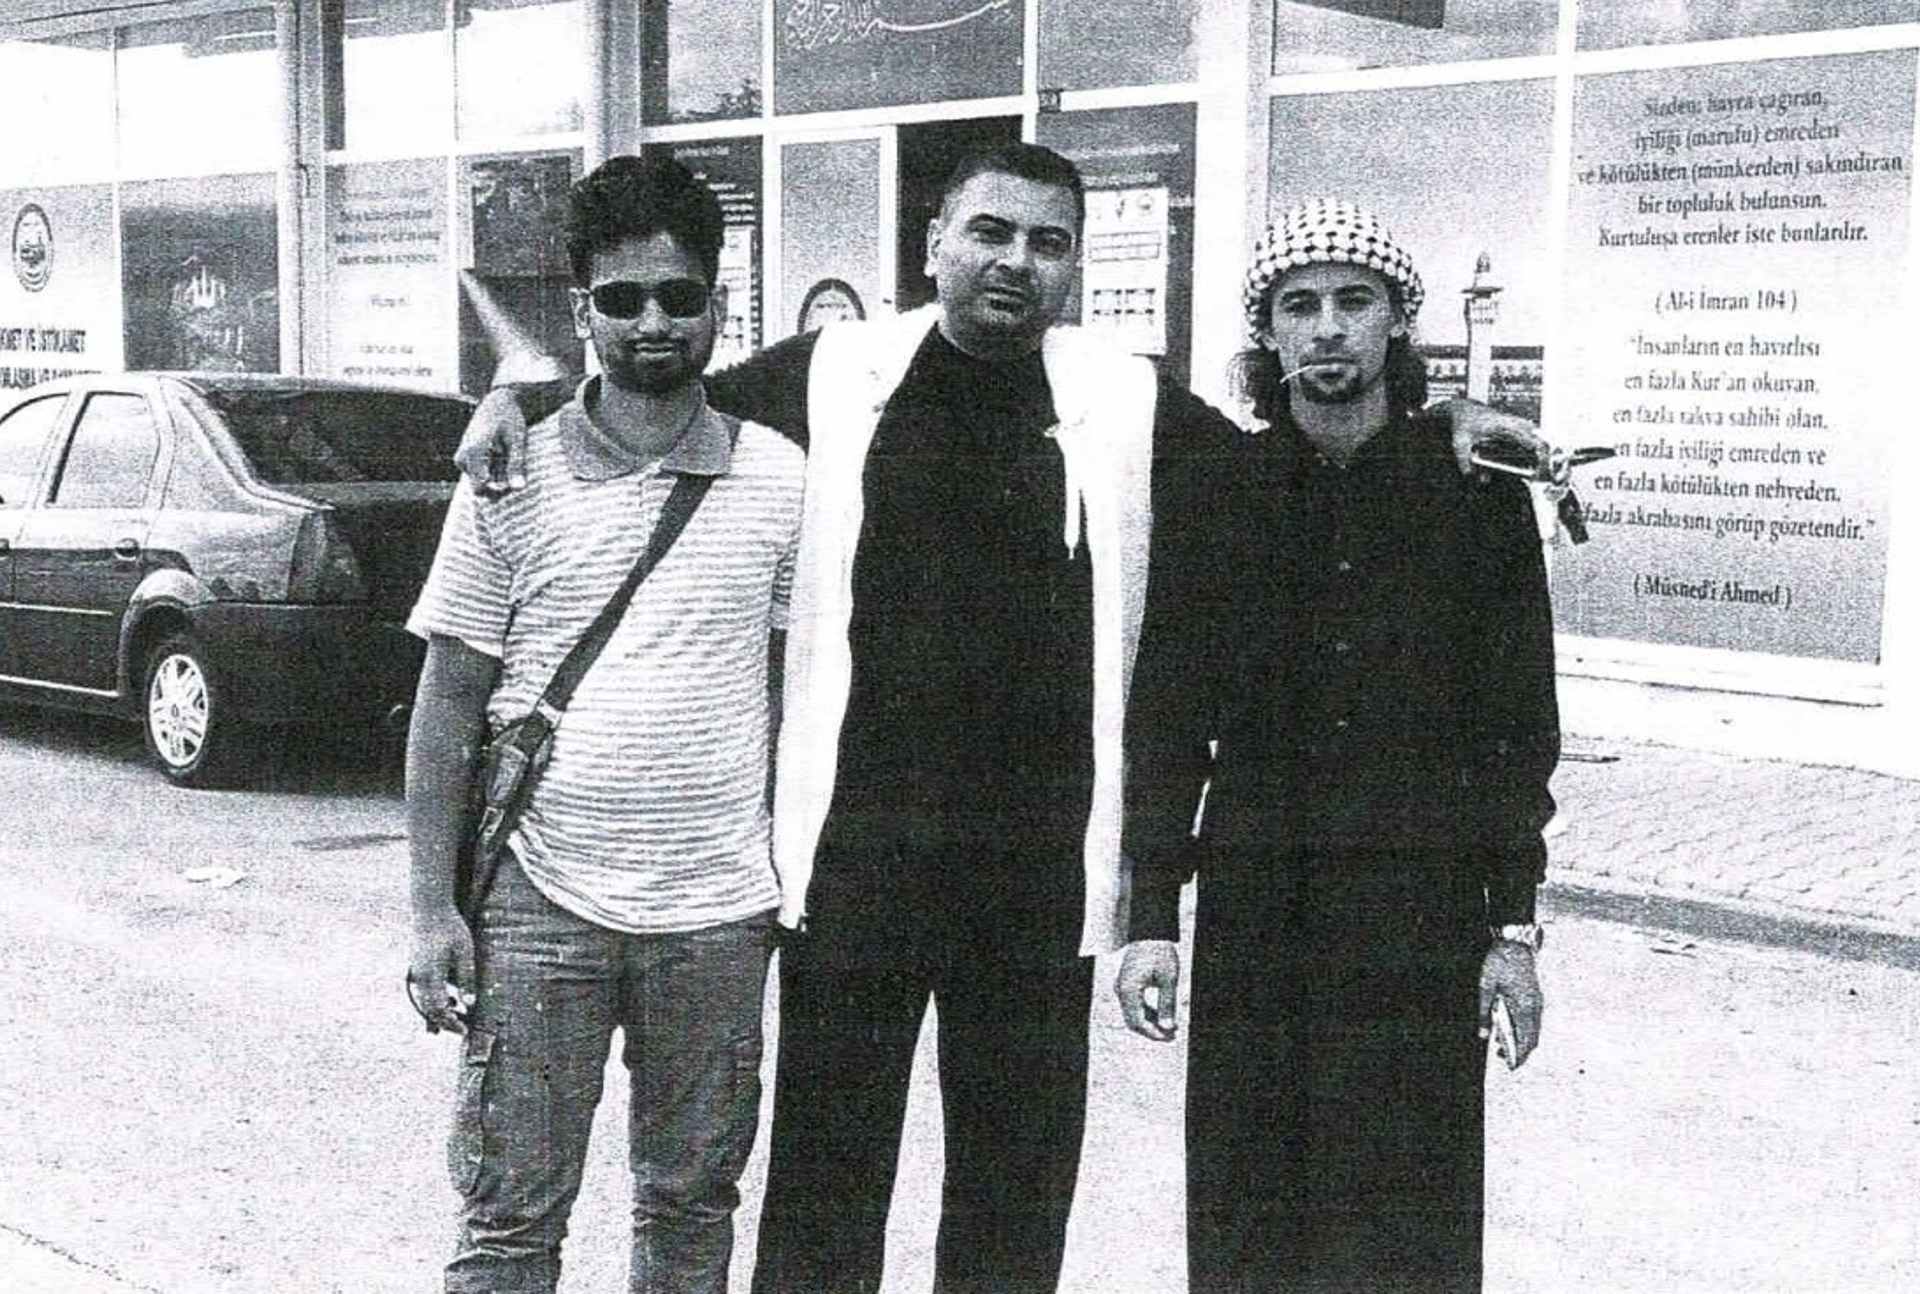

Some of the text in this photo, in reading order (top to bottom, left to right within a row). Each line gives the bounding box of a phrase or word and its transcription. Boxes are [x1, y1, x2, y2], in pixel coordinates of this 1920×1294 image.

[1686, 123, 1759, 150] (marufu)
[1764, 118, 1840, 143] emreden
[1577, 151, 1903, 186] ve kötülükten (münkerden) sakındıran
[1638, 189, 1827, 219] bir topluluk bulunsun.
[1599, 225, 1679, 251] Kurtuluşa
[1683, 223, 1740, 246] erenler
[1781, 220, 1868, 242] bunlardır.
[1700, 284, 1749, 311] İmran
[1724, 341, 1744, 356] en
[1624, 375, 1642, 390] en
[1649, 368, 1686, 391] fazla
[1612, 409, 1632, 424] en
[1637, 404, 1675, 424] fazla
[1680, 405, 1724, 426] takva
[1728, 405, 1780, 427] sahibi
[1636, 437, 1675, 459] fazla
[1729, 442, 1801, 464] emreden
[1807, 449, 1827, 465] ve
[1594, 475, 1613, 490] en
[1618, 470, 1656, 491] fazla
[1661, 472, 1749, 497] kötülükten
[1585, 502, 1622, 525] fazla
[1627, 504, 1711, 530] akrabasını
[1715, 512, 1765, 541] görüp
[1721, 580, 1780, 606] Ahmed
